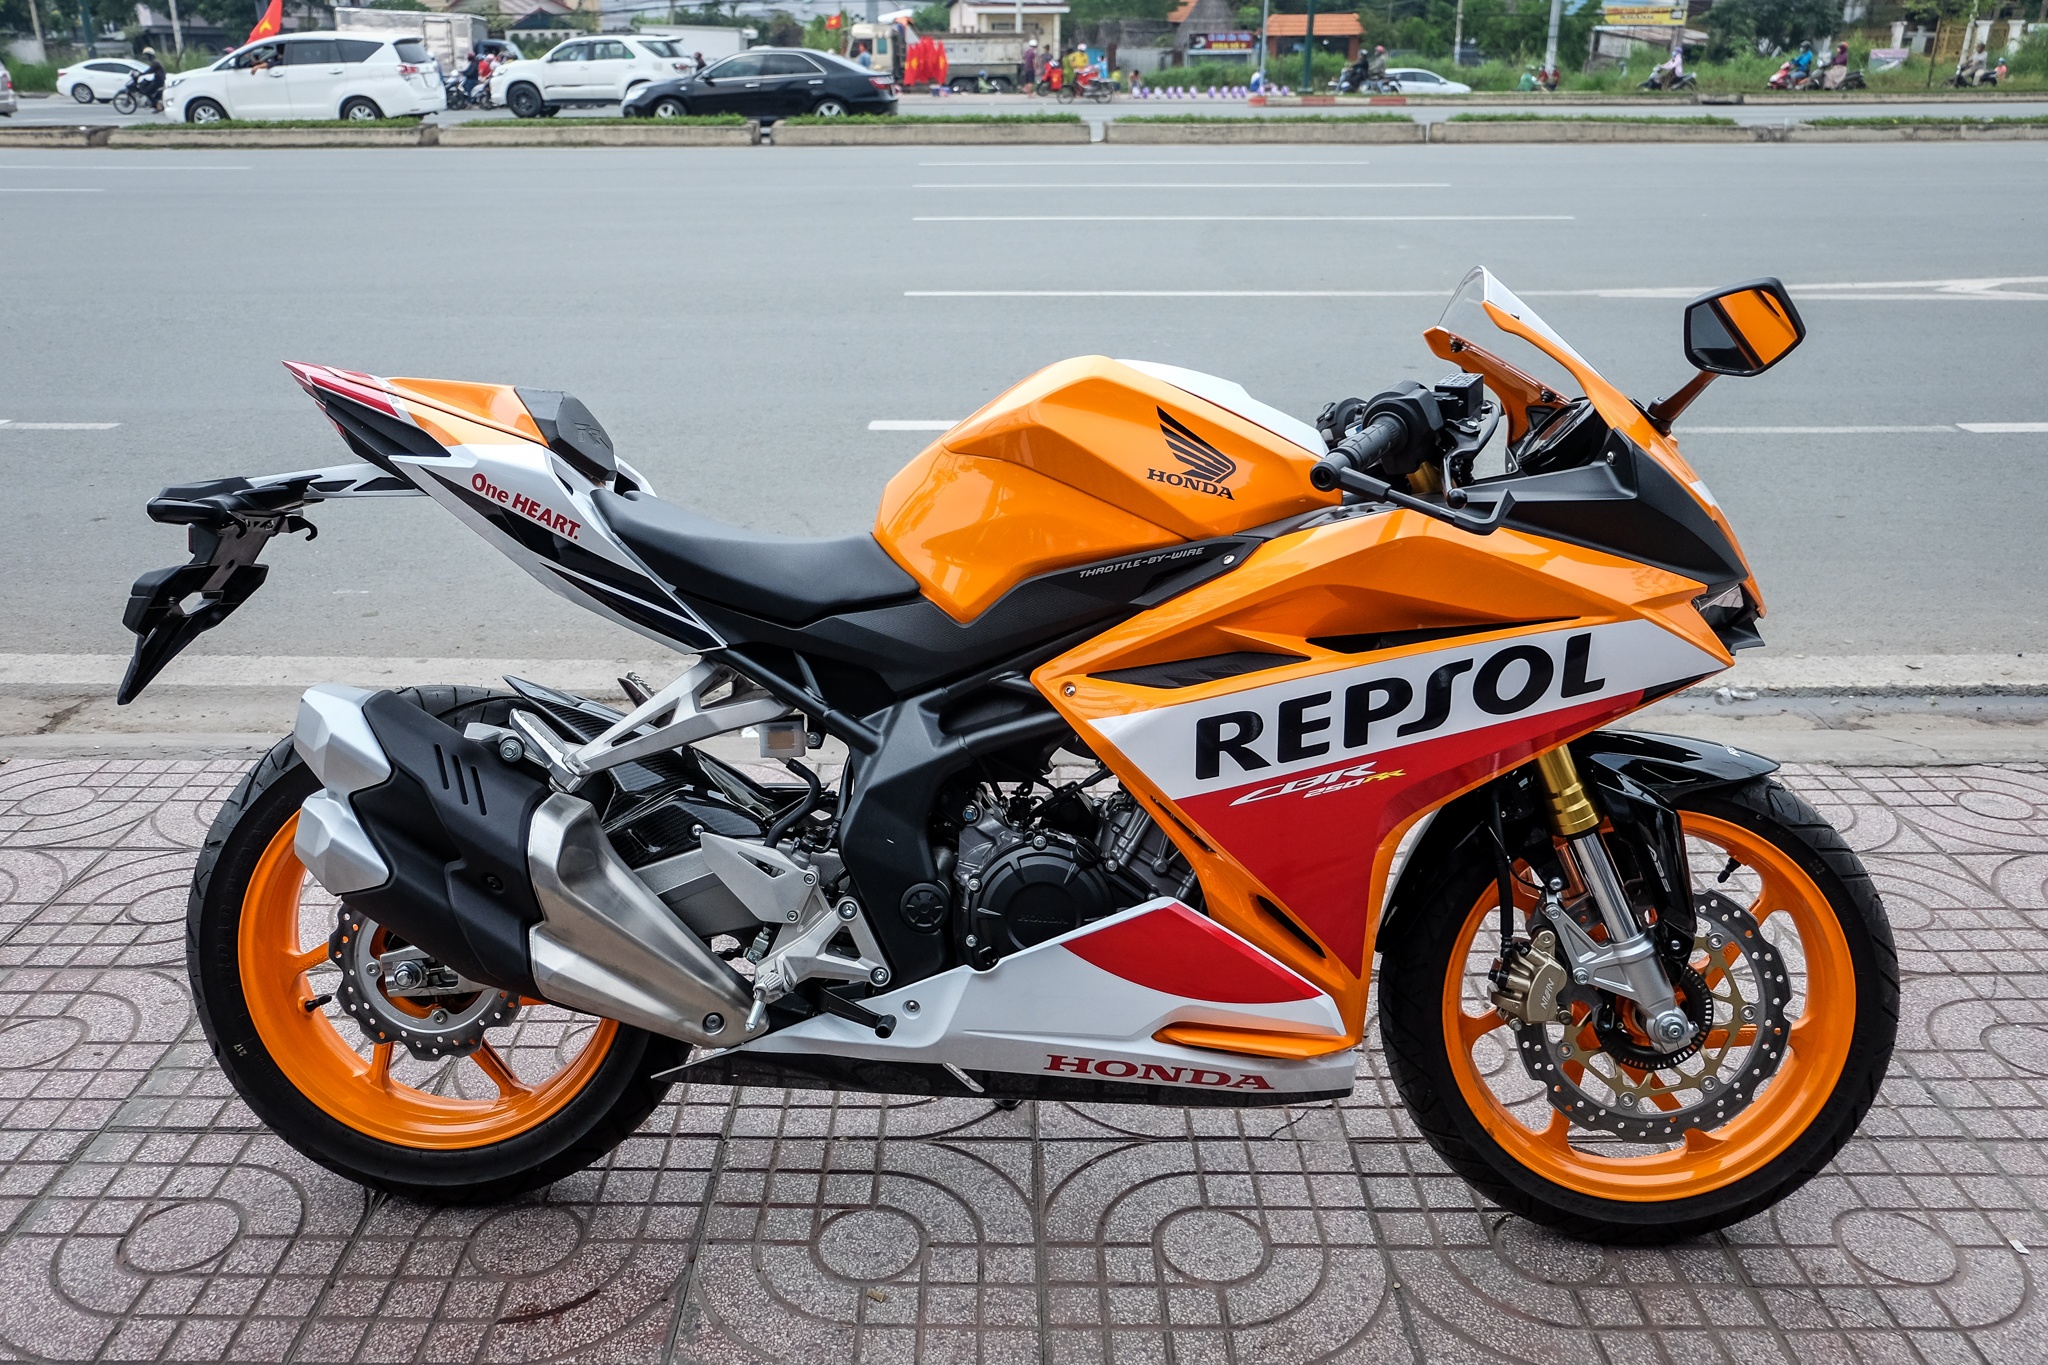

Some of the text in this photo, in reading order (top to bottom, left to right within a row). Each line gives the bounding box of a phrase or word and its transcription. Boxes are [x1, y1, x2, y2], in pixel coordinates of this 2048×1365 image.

[1146, 468, 1235, 501] HONDA
[472, 472, 581, 539] One HEART.
[1079, 547, 1205, 579] THROTTLE-BY-WIRE
[1194, 631, 1607, 781] REPSOL
[1229, 761, 1377, 807] CBR
[1016, 913, 1069, 925] HONDA
[1043, 1054, 1275, 1090] HONDA
